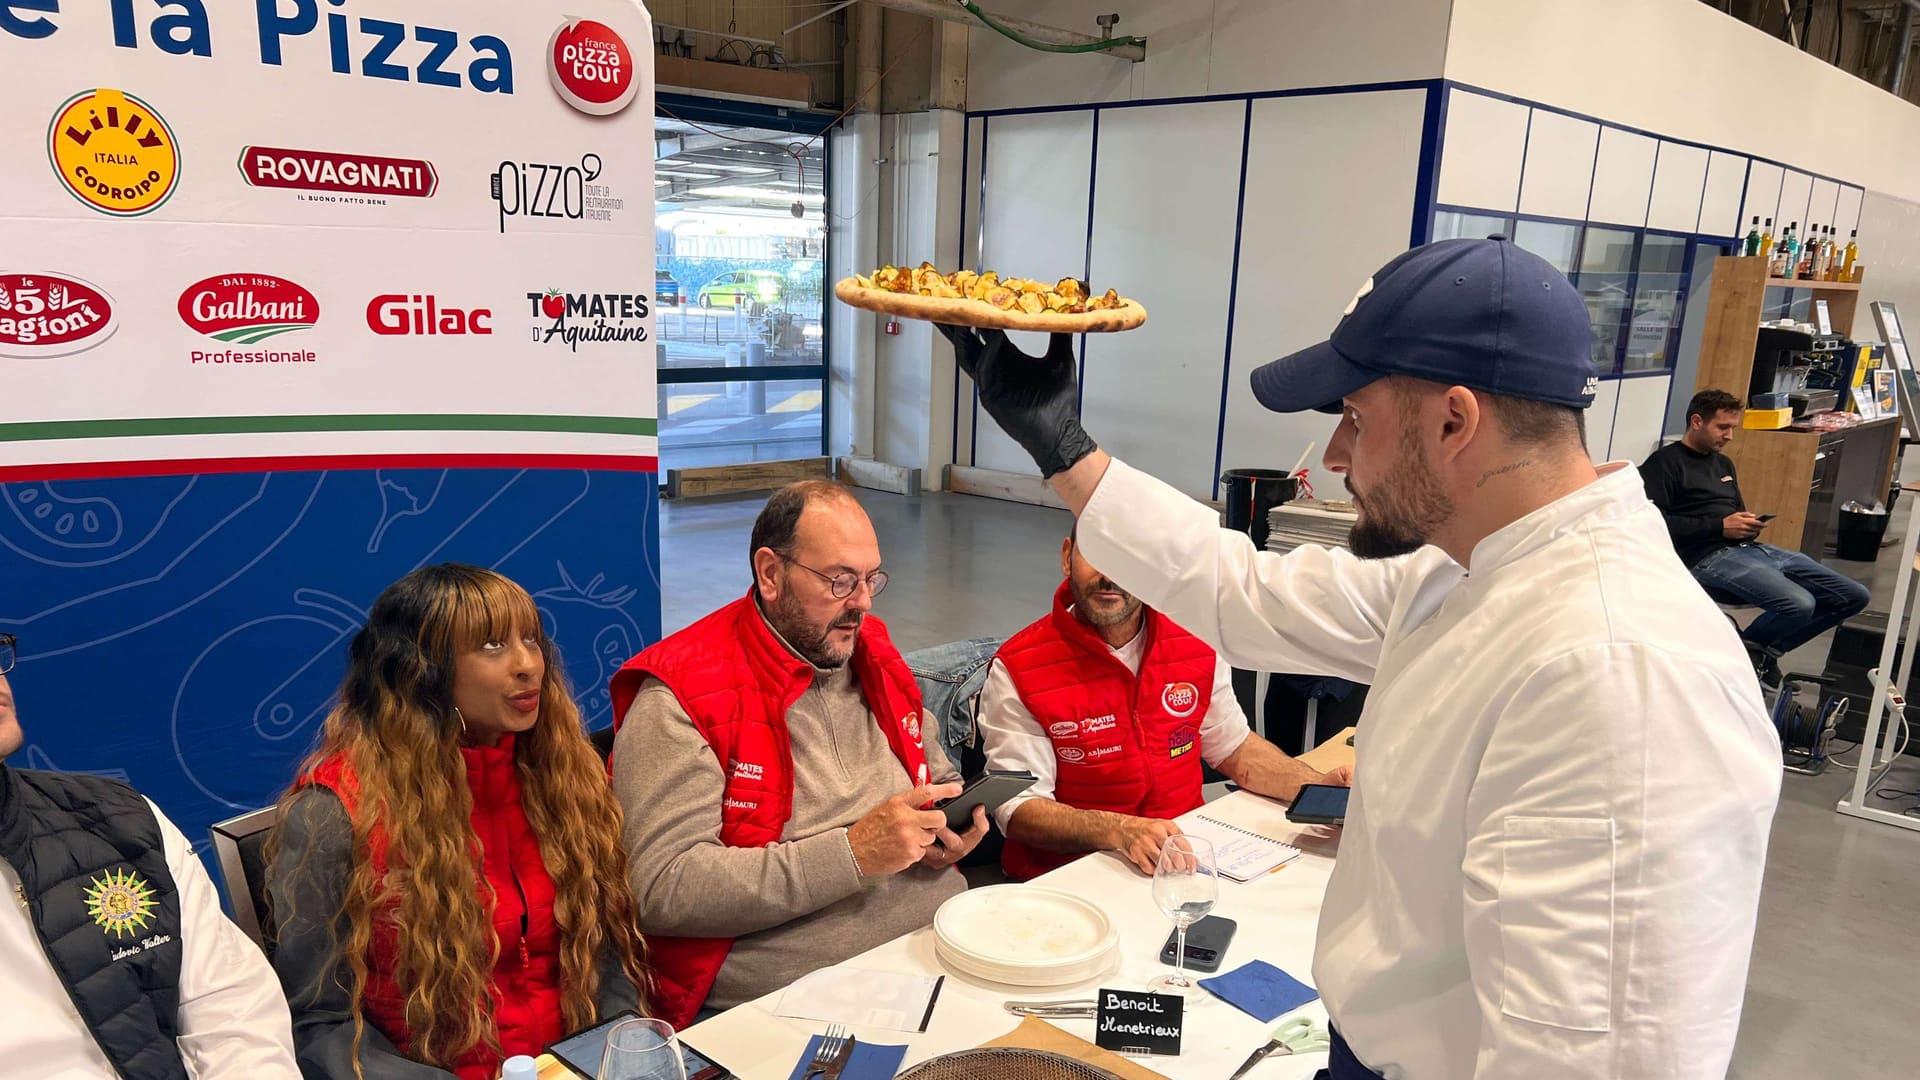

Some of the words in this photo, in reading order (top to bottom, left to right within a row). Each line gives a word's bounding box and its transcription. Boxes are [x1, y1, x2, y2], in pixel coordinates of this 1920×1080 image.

[110, 0, 213, 58] la
[255, 0, 514, 95] Pizza
[584, 37, 617, 52] france
[563, 42, 620, 67] pizza
[573, 59, 621, 85] tour
[65, 106, 165, 149] Lilly
[94, 152, 139, 166] ITALIA
[256, 155, 423, 190] ROVAGNATI
[75, 165, 161, 200] CODROIPO
[585, 184, 602, 196] TOUTE
[602, 186, 610, 197] LA
[308, 195, 336, 203] BUONO
[339, 197, 364, 205] FATTO
[21, 276, 34, 287] le
[14, 288, 46, 315] 5
[192, 290, 307, 322] Galbani
[366, 294, 492, 335] Gilac
[191, 349, 316, 364] Professionale
[1168, 690, 1192, 702] pizza
[1173, 697, 1192, 706] tour
[734, 761, 763, 774] MATES
[111, 946, 141, 961] udovic
[1105, 993, 1165, 1013] Benoit
